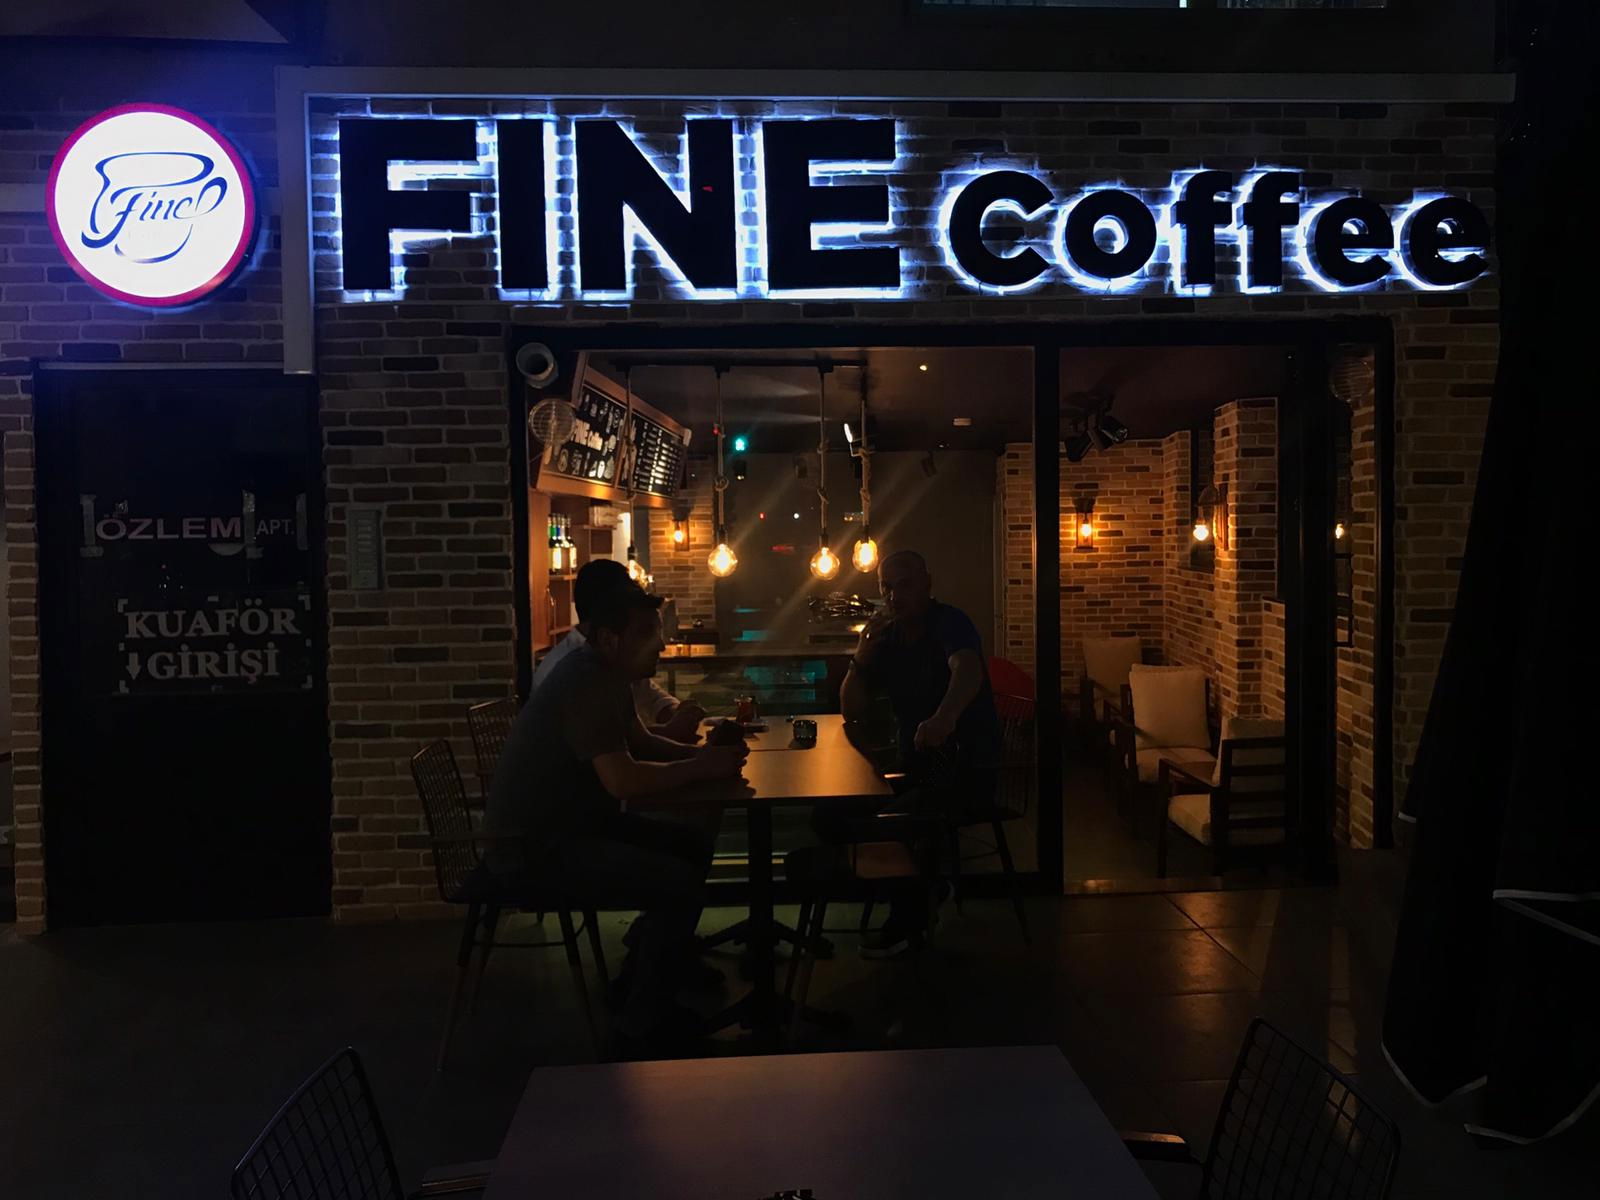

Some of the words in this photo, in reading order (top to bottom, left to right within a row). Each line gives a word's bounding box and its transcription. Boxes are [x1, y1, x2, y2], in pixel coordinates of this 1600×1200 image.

[339, 118, 901, 291] FINE
[96, 513, 242, 541] ÖZLEM
[256, 518, 296, 537] APT.
[124, 597, 302, 639] KUAFÖR
[147, 642, 281, 685] GİRİŞİ
